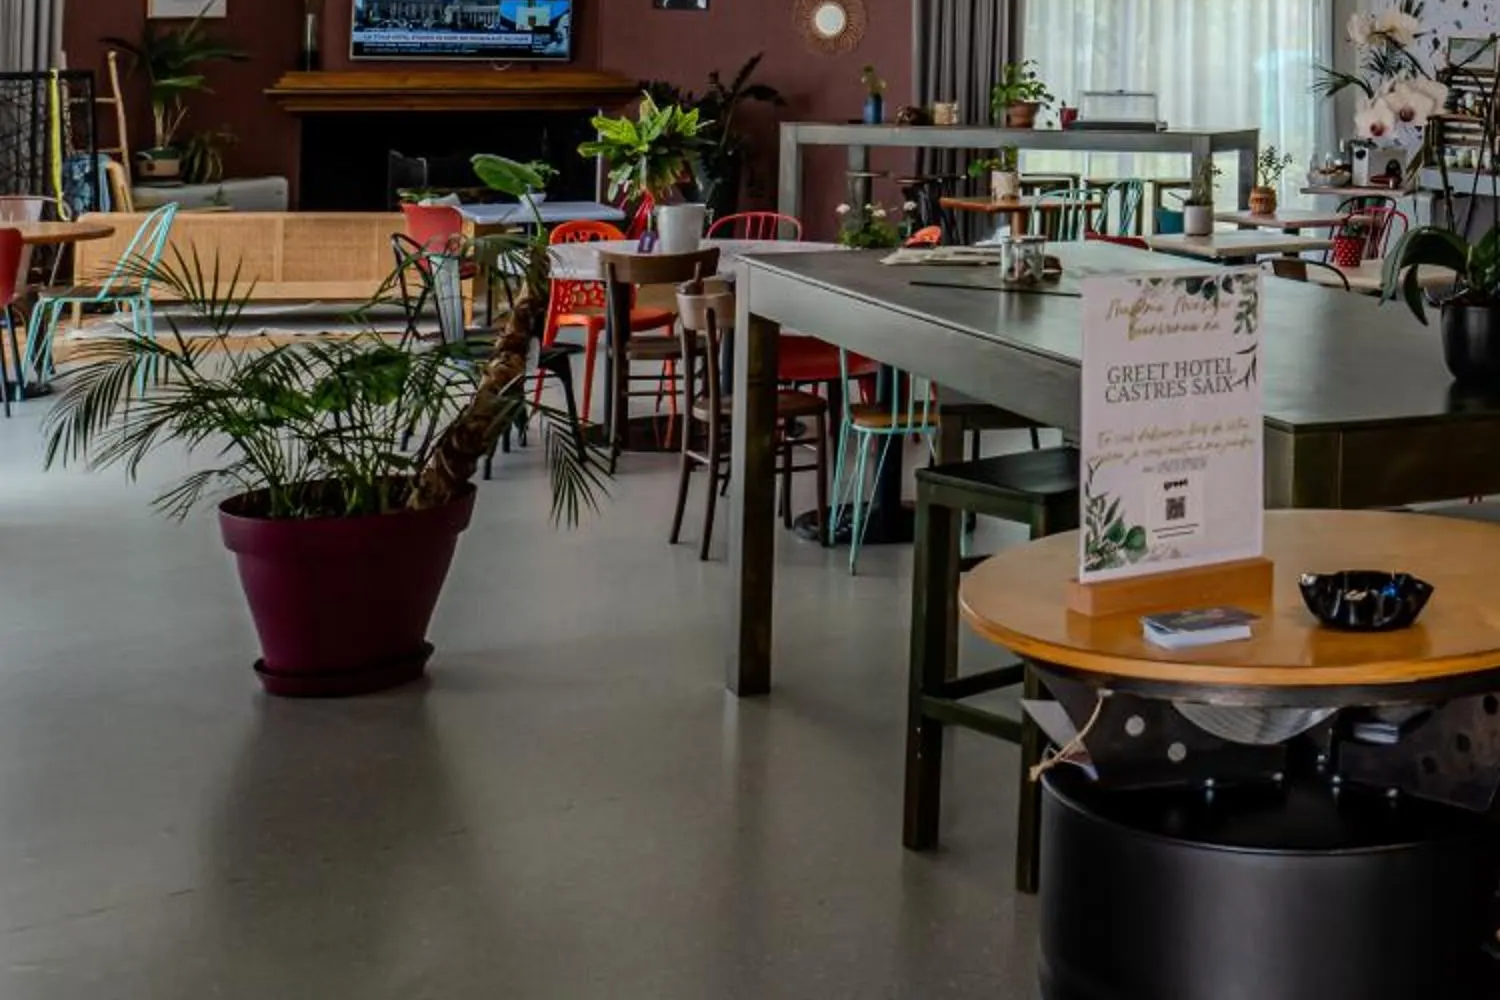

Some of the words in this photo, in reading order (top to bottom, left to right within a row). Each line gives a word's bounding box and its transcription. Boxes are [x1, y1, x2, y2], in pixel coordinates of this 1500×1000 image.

[1107, 361, 1170, 385] GREET
[1175, 356, 1237, 379] HOTEL
[1105, 379, 1187, 404] CASTRES
[1191, 375, 1234, 396] SAIX
